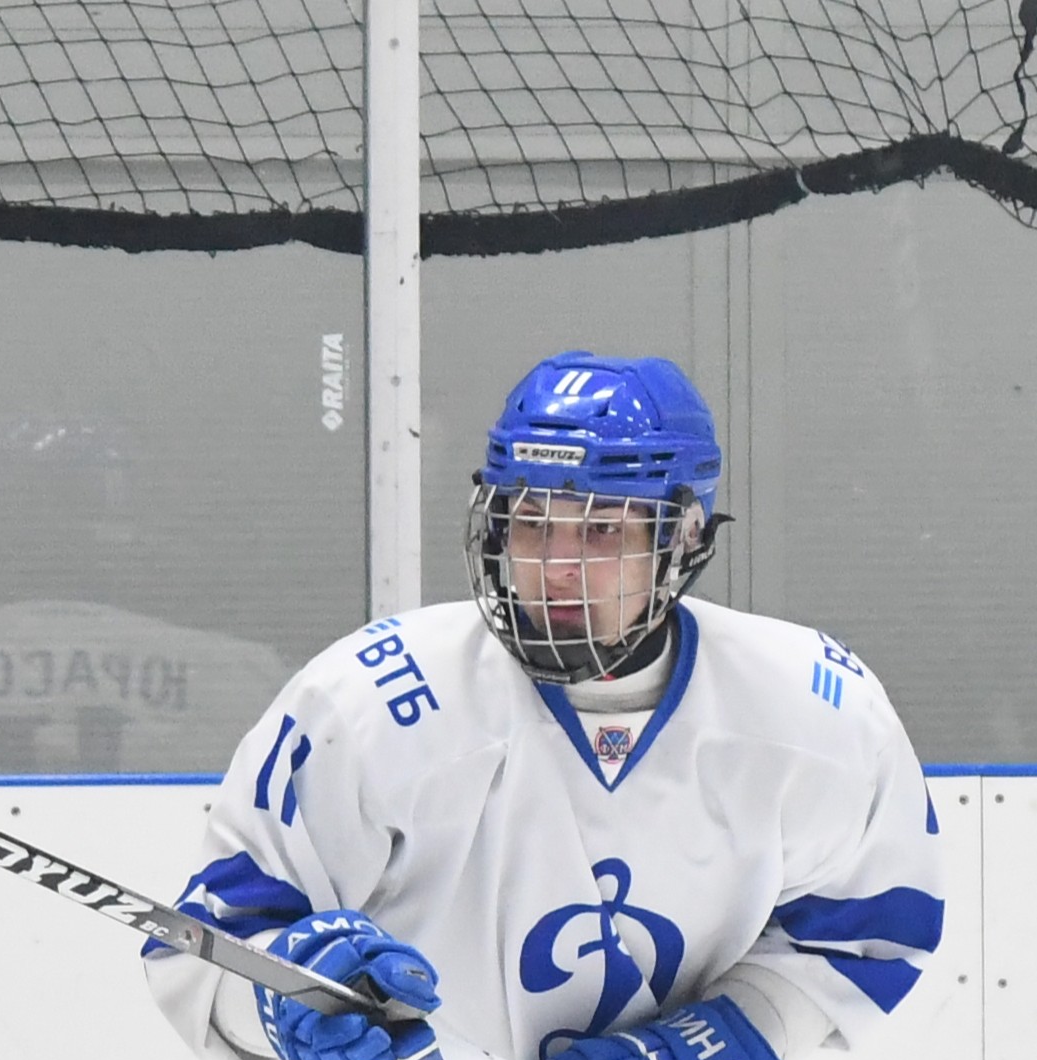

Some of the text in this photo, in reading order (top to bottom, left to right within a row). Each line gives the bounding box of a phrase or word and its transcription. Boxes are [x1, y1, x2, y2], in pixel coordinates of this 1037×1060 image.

[322, 333, 344, 410] RAITA
[553, 370, 593, 395] 11
[531, 448, 576, 461] SOYUZ
[355, 633, 441, 727] ВТБ
[253, 713, 313, 829] 11
[138, 918, 170, 938] BC
